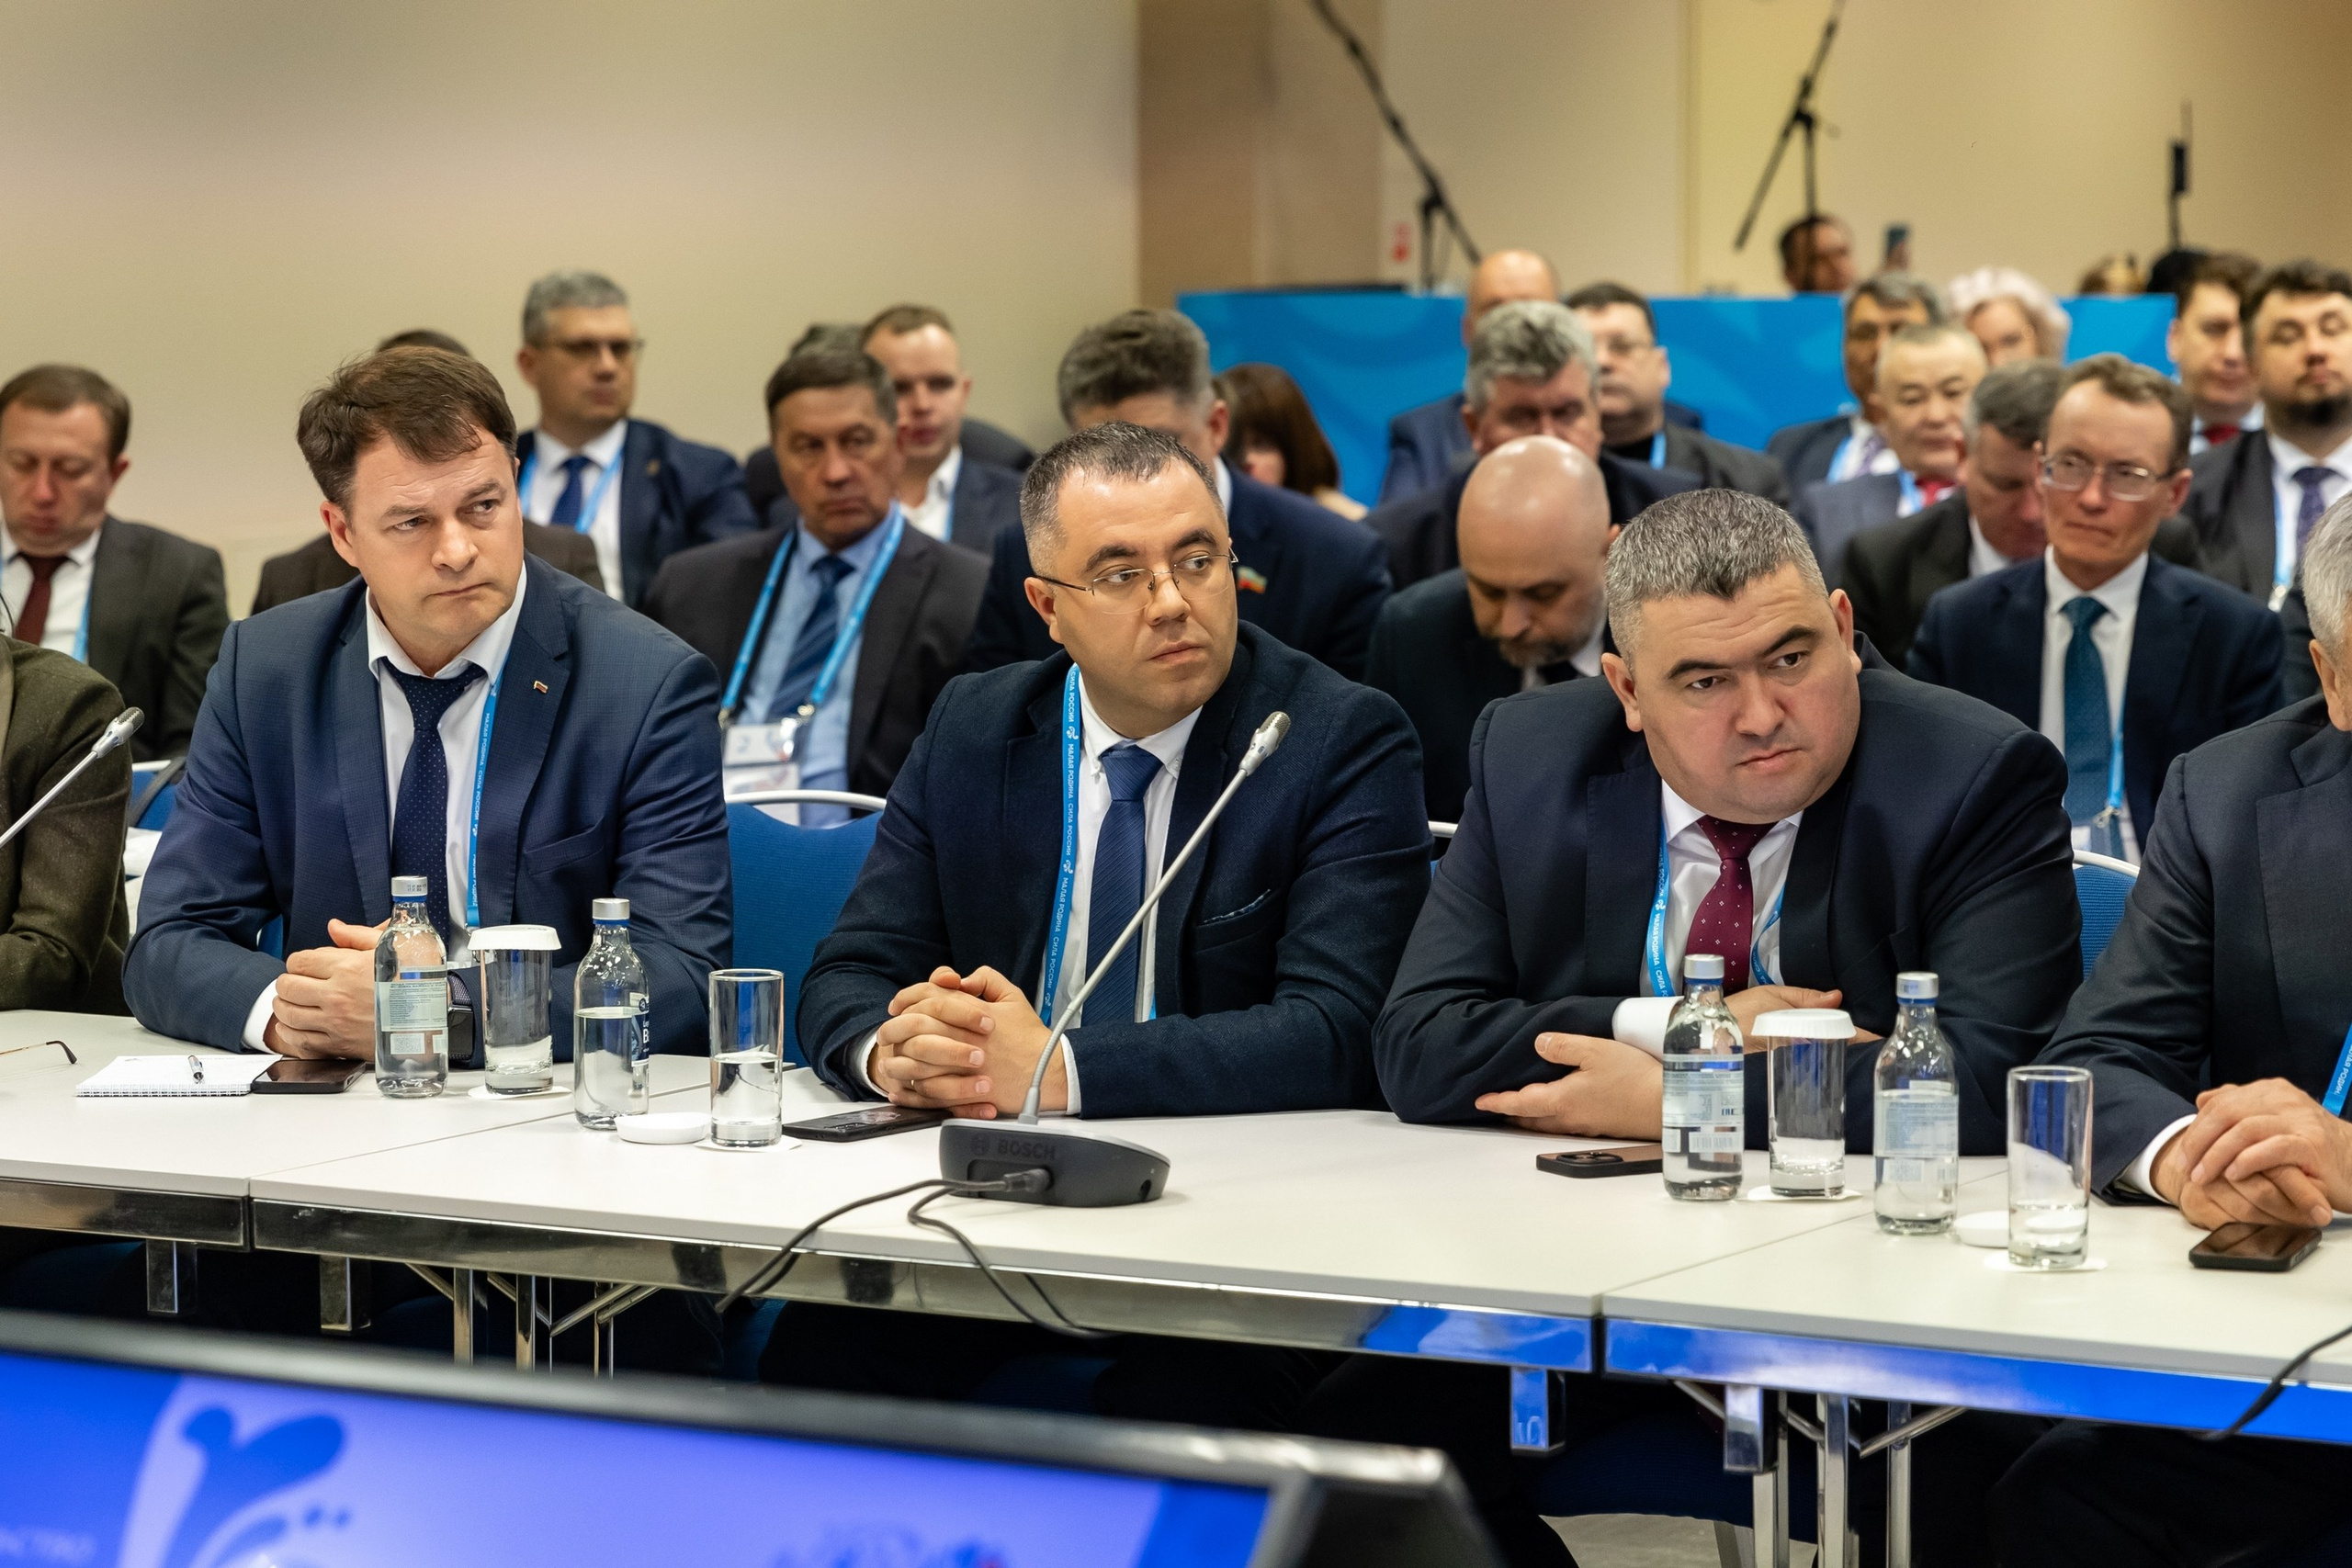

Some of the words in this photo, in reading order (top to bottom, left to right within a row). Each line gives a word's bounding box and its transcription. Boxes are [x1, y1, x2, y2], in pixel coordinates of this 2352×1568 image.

[479, 738, 487, 766] РОДИНА
[1065, 825, 1073, 856] РОССИИ
[1059, 877, 1069, 904] МАЛАЯ
[1054, 904, 1064, 932] РОДИНА
[1050, 936, 1059, 957] СИЛА
[1046, 957, 1056, 988] РОССИИ
[1652, 936, 1660, 965] РОДИНА
[1656, 969, 1666, 990] СИЛА
[2335, 1067, 2349, 1096] РОДИН
[998, 1139, 1056, 1159] BOSCH
